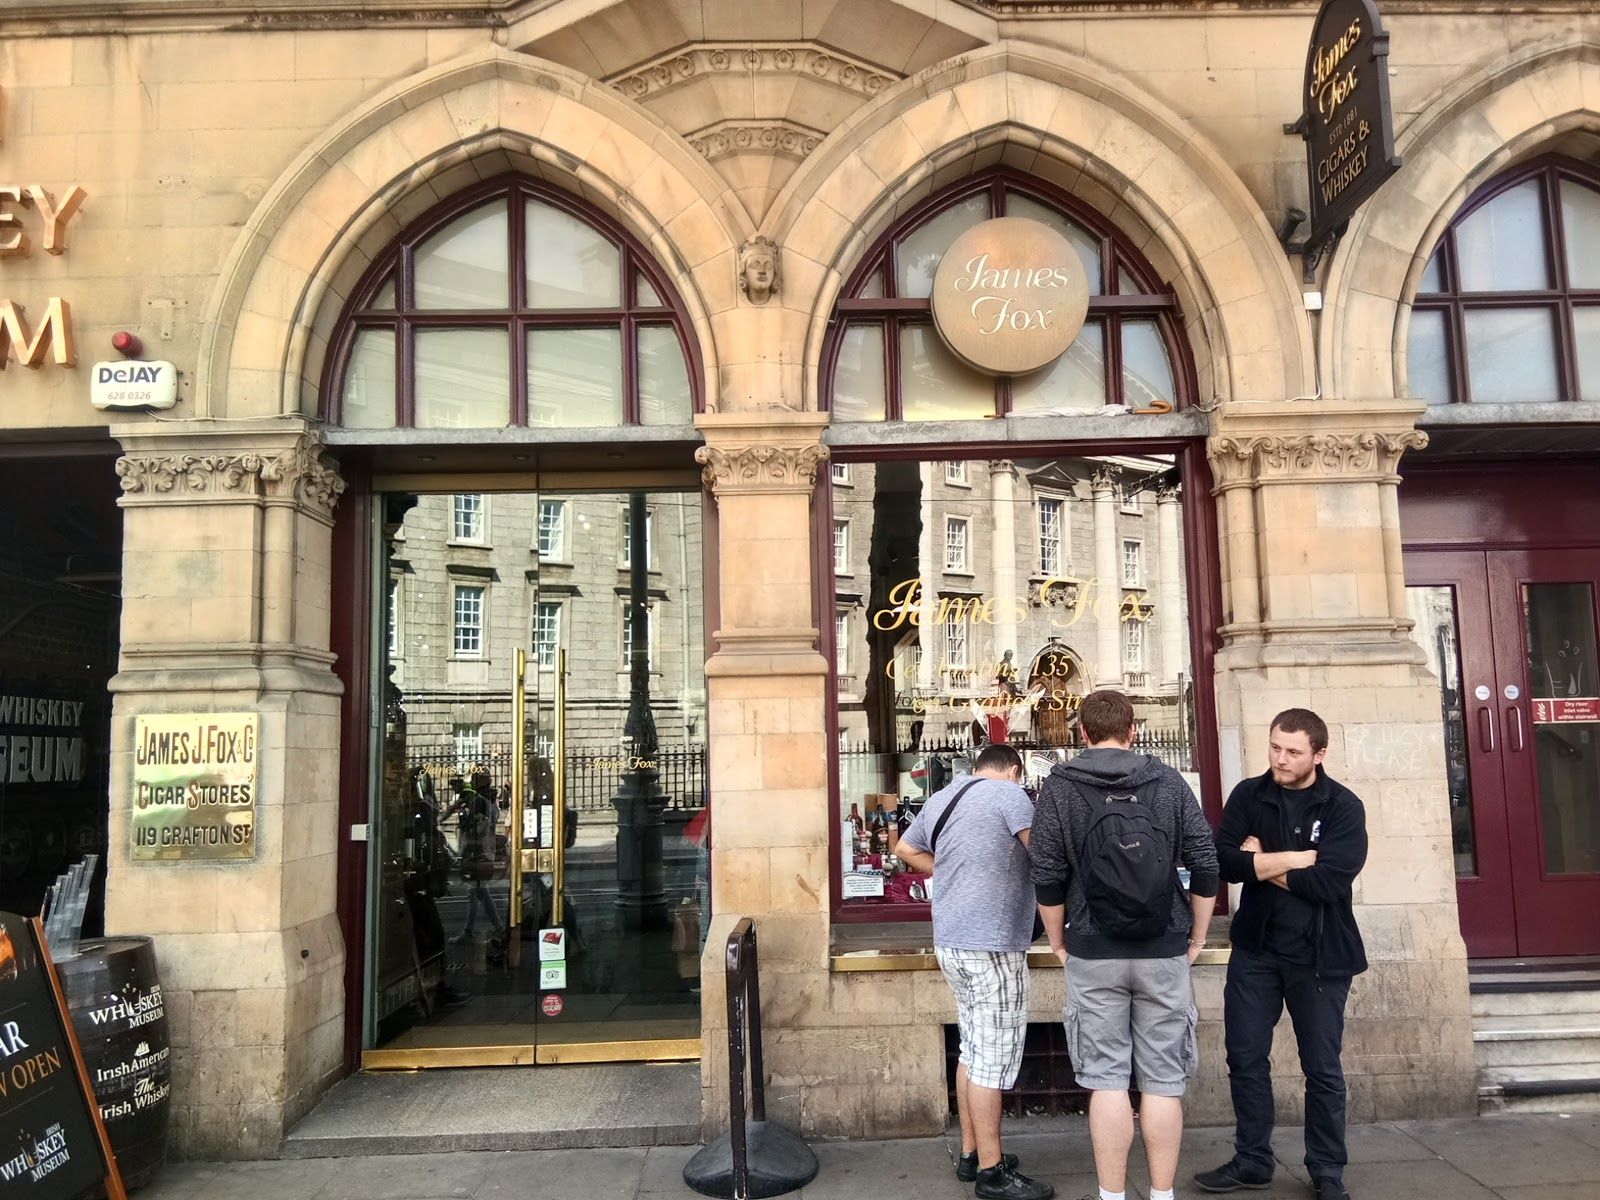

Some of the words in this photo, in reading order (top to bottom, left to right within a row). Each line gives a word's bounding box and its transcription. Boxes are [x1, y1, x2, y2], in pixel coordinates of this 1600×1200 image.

[1310, 17, 1360, 98] James
[1319, 65, 1357, 125] Fox
[1318, 131, 1356, 184] CIGARS
[1359, 119, 1370, 141] &
[1322, 145, 1368, 207] WHISKEY
[953, 252, 1068, 294] James
[971, 295, 1053, 335] Fox
[98, 366, 162, 384] DeJAY
[108, 391, 125, 400] 628
[128, 391, 152, 400] 0326
[873, 577, 1029, 631] James
[1040, 576, 1152, 629] Fox
[886, 655, 1020, 684] Cebrating
[1031, 655, 1071, 677] 135
[1047, 689, 1082, 713] Str
[137, 726, 189, 765] JAMES
[419, 762, 457, 776] James
[589, 757, 626, 770] James
[627, 756, 657, 770] Fox
[138, 782, 185, 809] CIGAR
[187, 780, 250, 810] STORES
[136, 827, 156, 847] 119
[161, 825, 229, 846] GRAFTON
[129, 1006, 164, 1029] MUSEUM
[11, 1046, 62, 1090] OPEN
[134, 1078, 155, 1097] The
[99, 1101, 132, 1120] Irish
[31, 1148, 70, 1183] MUSEUM
